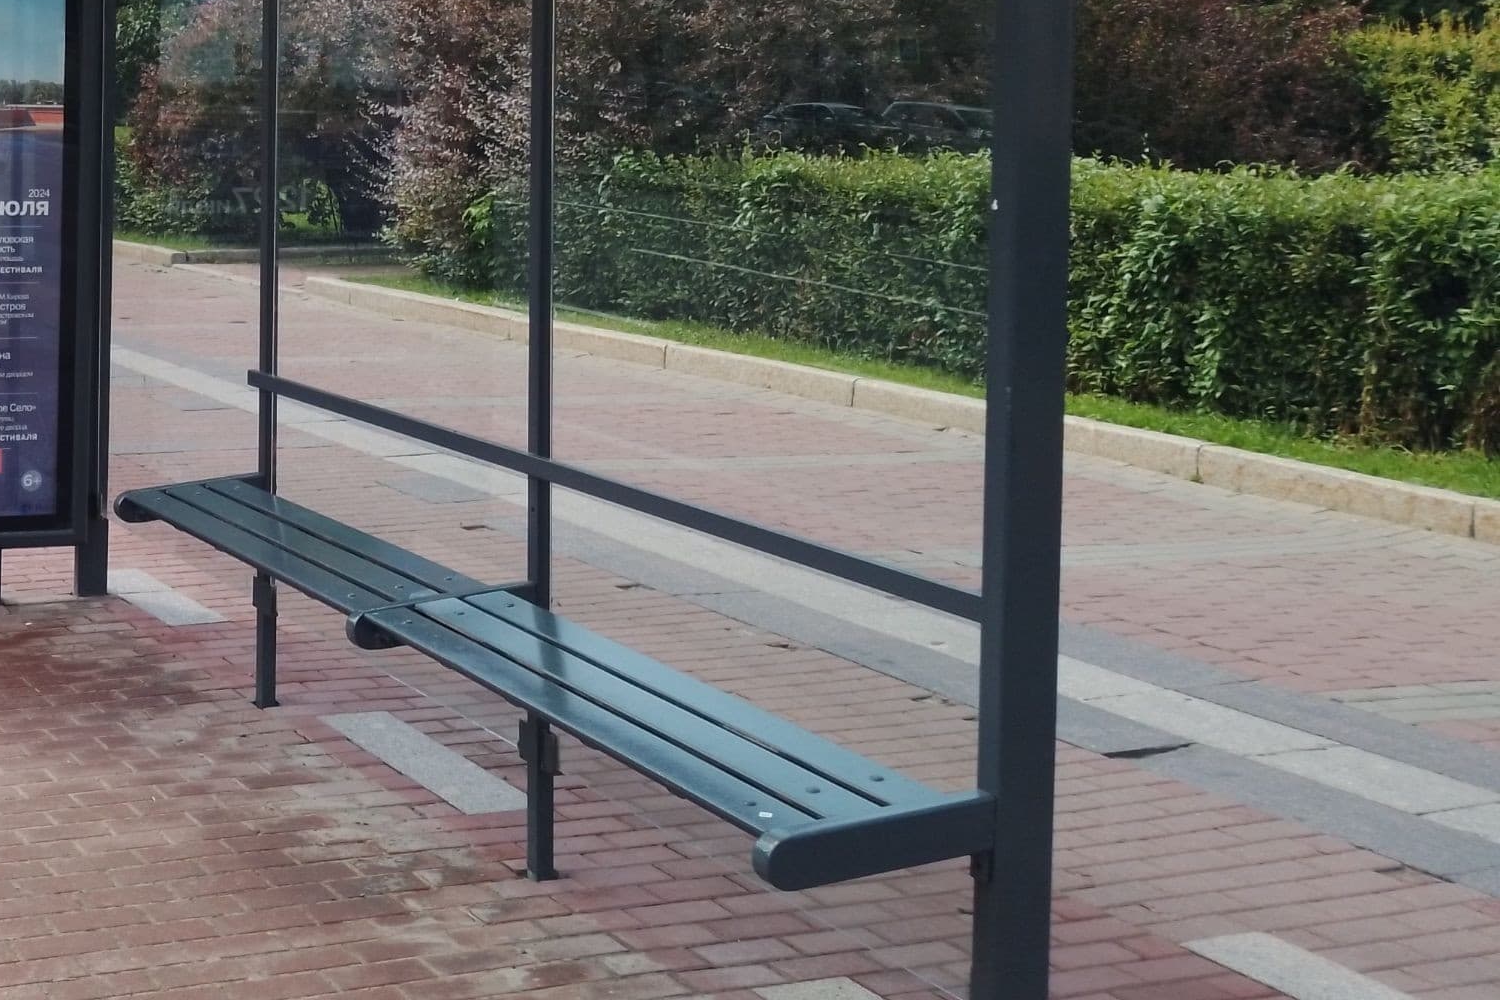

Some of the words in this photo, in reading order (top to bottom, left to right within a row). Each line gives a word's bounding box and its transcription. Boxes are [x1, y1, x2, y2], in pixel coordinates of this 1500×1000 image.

[28, 188, 50, 198] 2024
[9, 403, 37, 412] Село»
[23, 475, 41, 488] 6+
